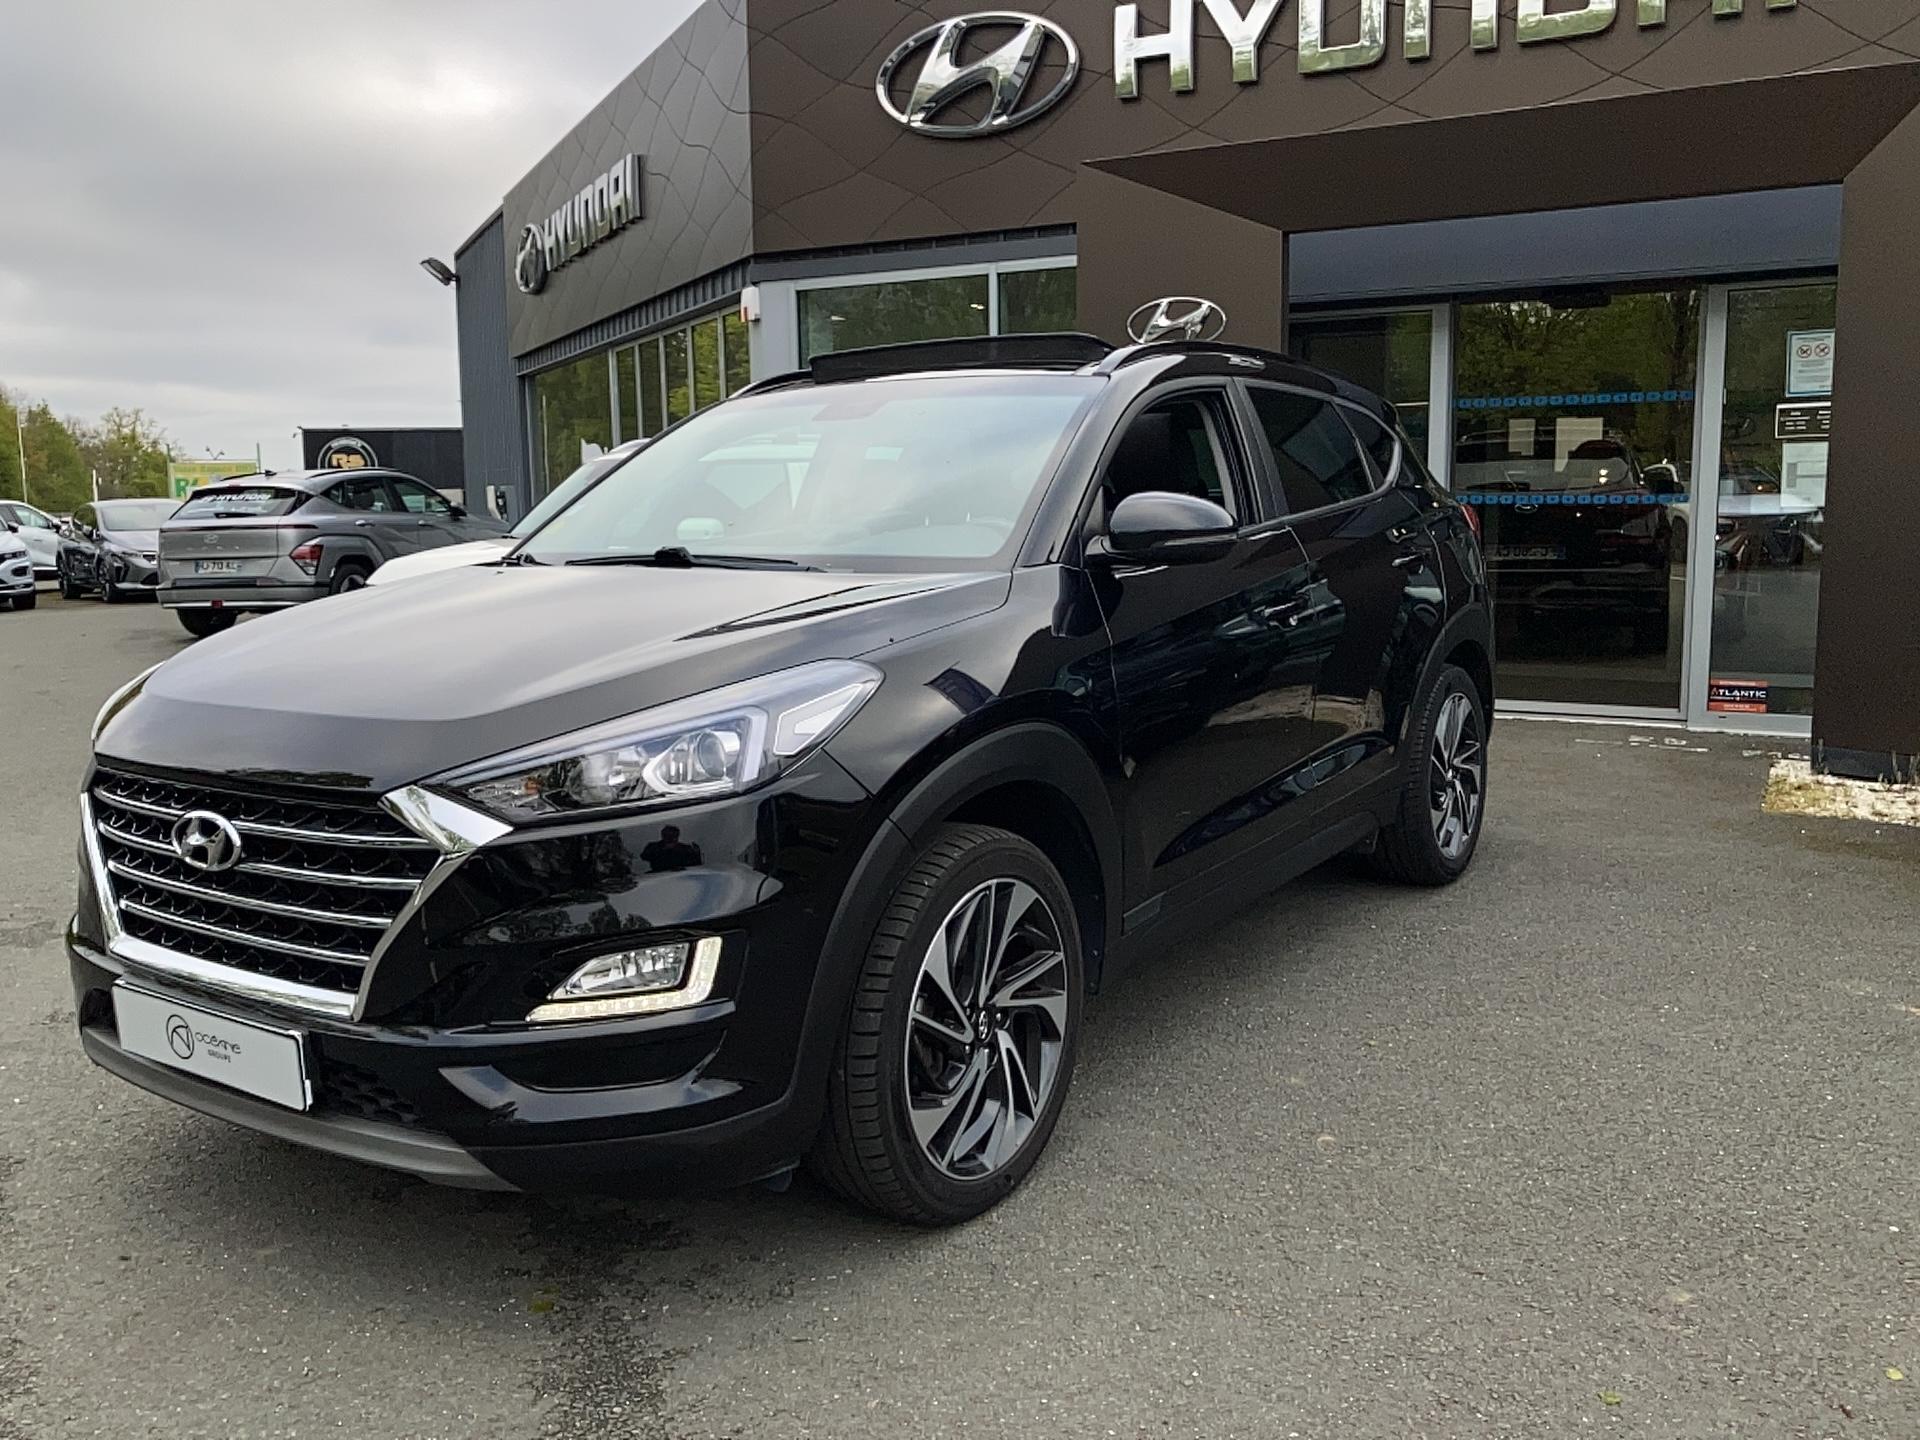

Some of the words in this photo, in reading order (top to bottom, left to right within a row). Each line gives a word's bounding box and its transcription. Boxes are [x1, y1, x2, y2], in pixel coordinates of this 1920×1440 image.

[1114, 0, 1799, 98] HYUN
[544, 153, 642, 271] HYUNDAI
[1711, 688, 1767, 699] ATLANTIC
